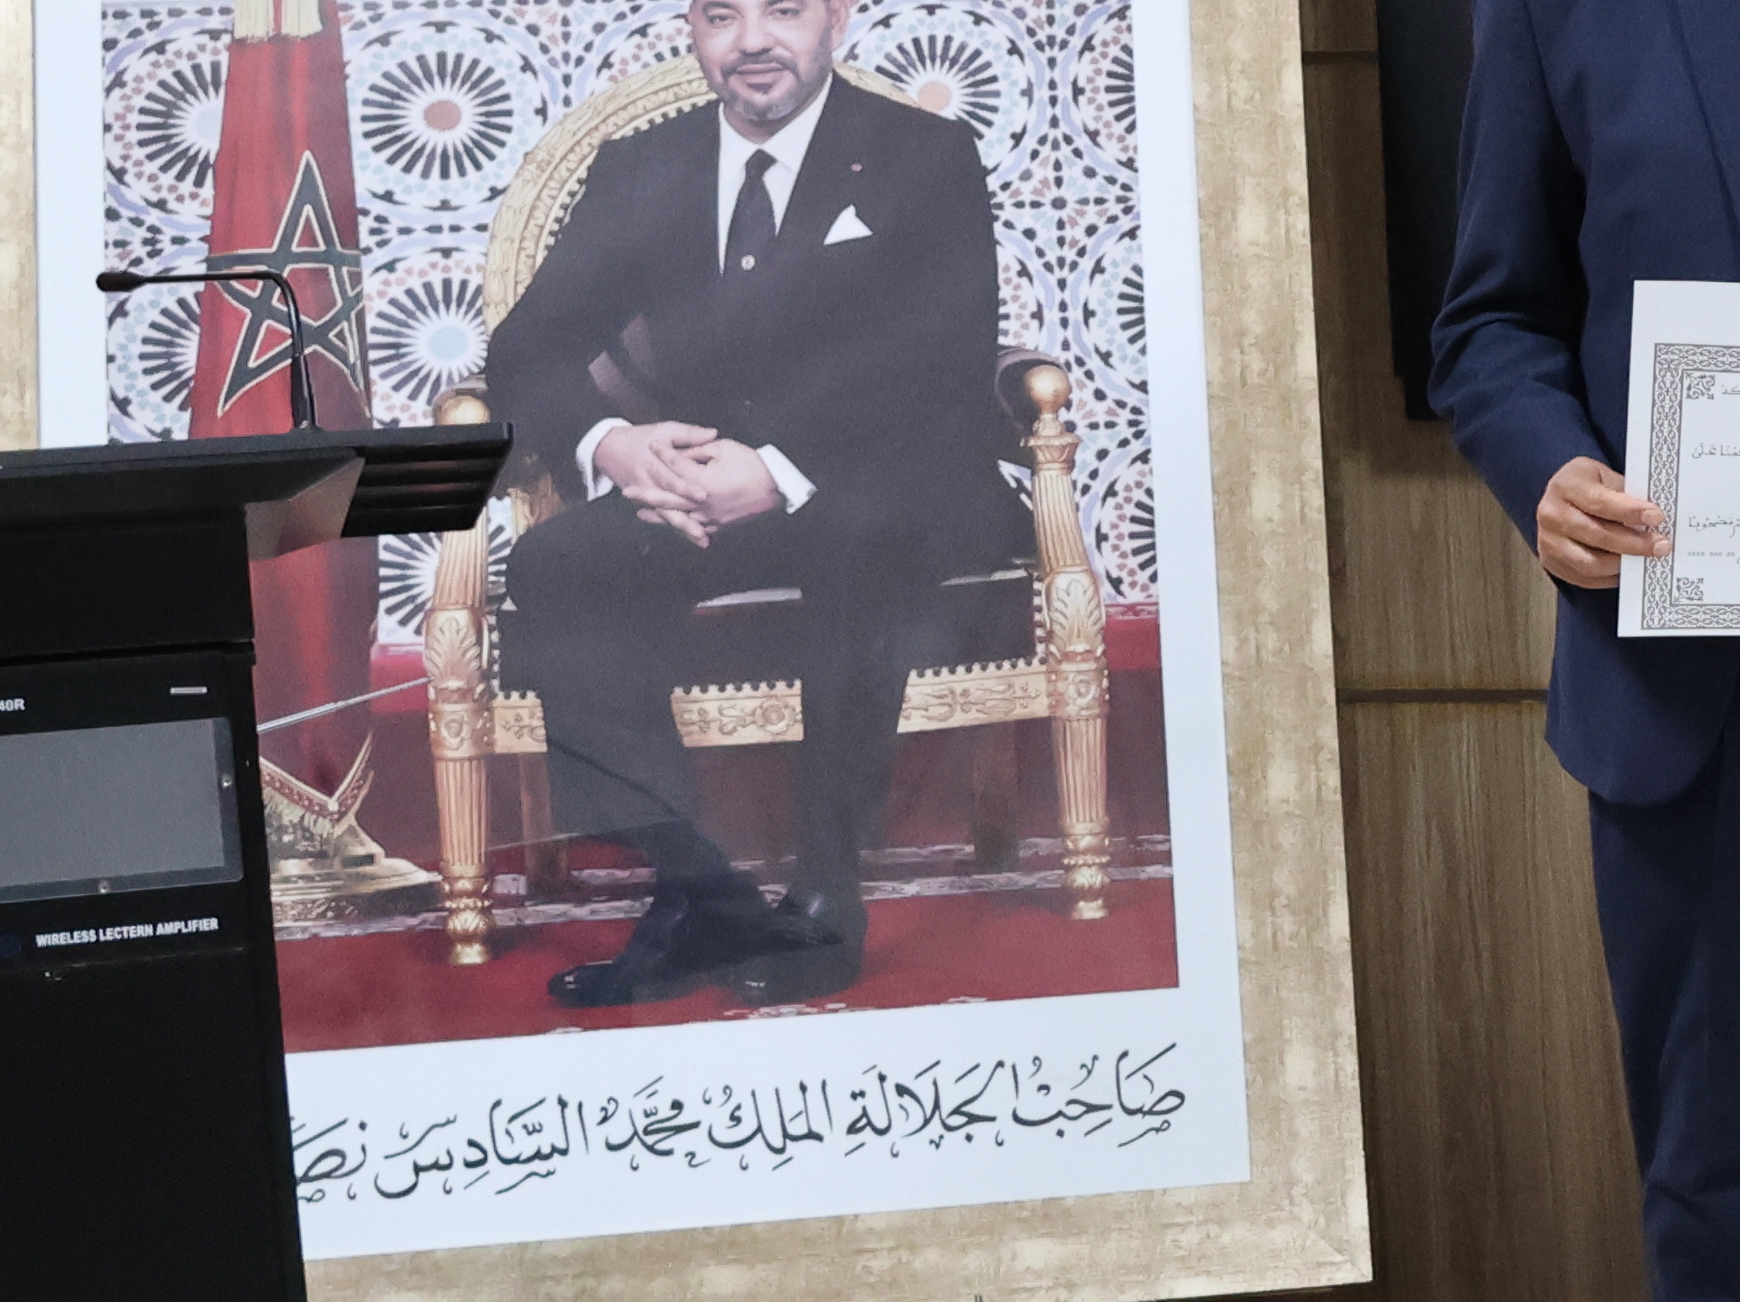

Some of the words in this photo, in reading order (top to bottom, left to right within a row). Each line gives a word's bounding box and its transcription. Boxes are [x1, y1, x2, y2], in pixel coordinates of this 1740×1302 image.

[36, 929, 97, 948] WIRELESS
[99, 924, 154, 942] LECTERN
[156, 917, 219, 936] AMPLIFIER
